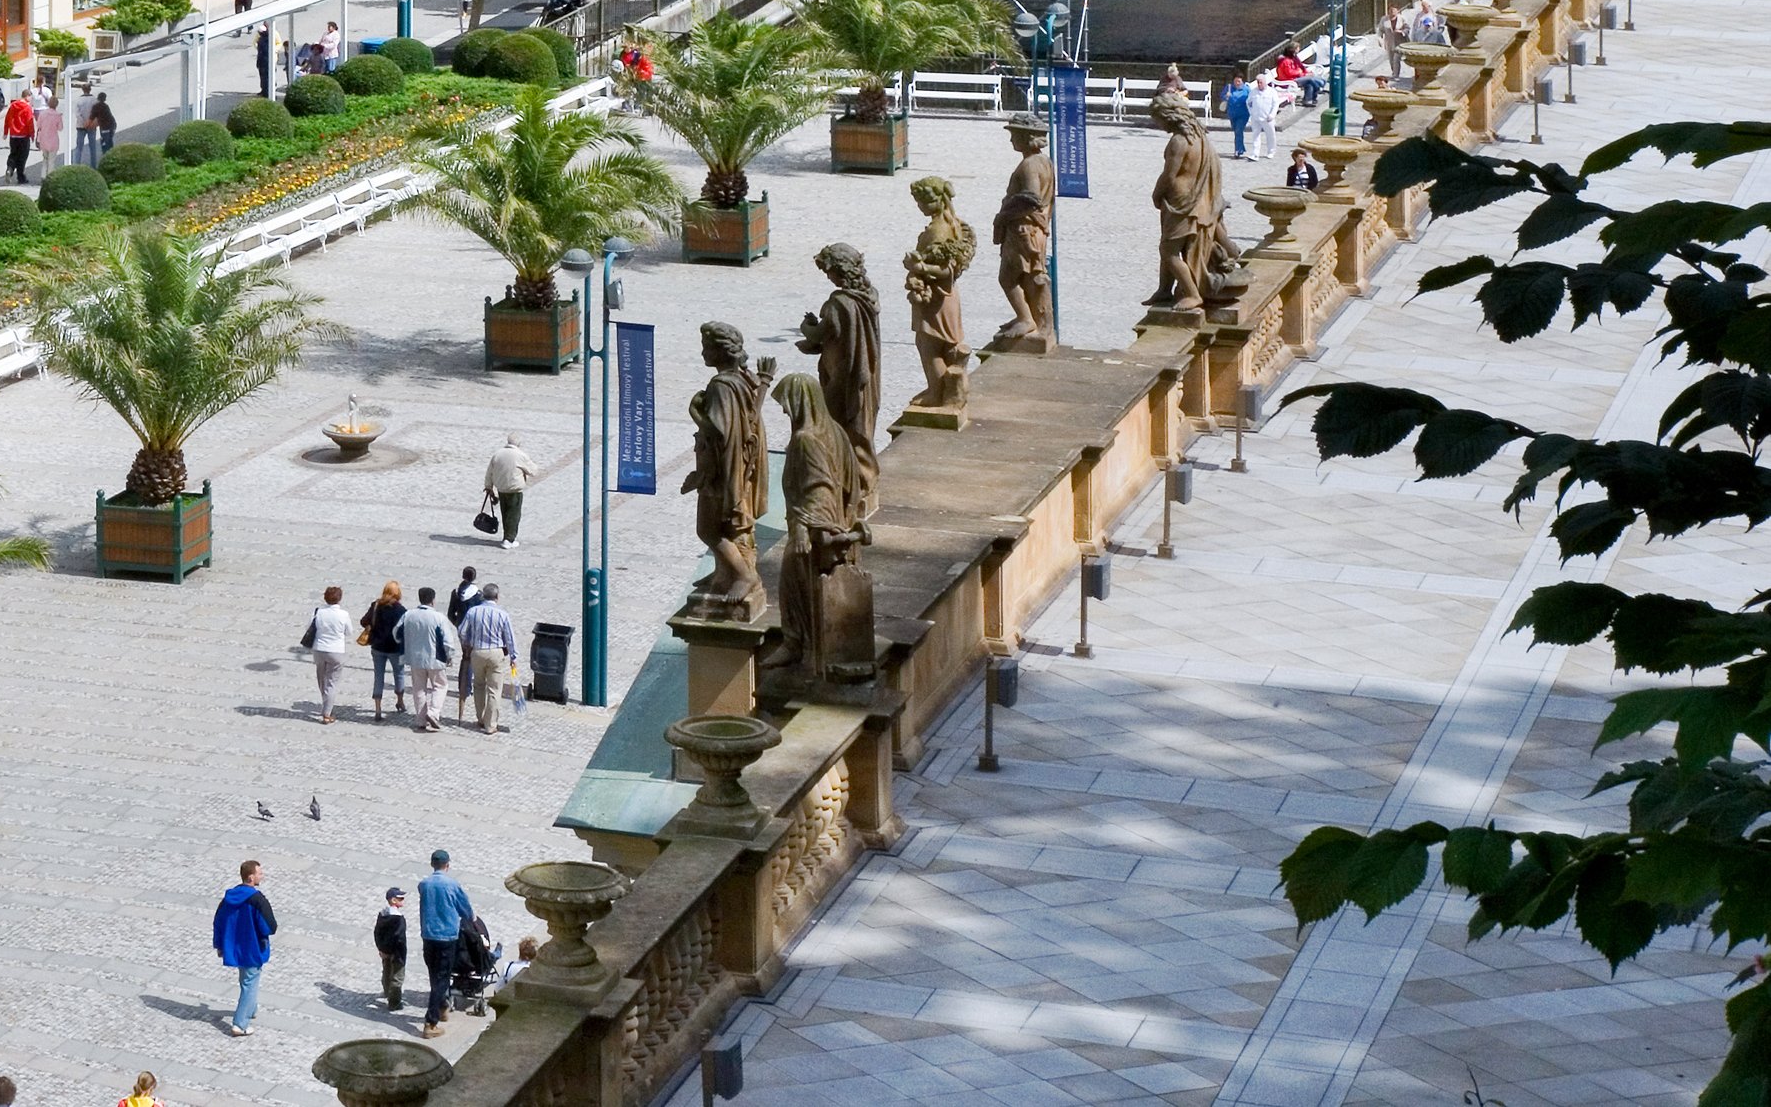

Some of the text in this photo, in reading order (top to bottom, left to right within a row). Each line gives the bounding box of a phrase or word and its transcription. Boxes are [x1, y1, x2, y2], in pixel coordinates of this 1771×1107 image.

[1069, 126, 1077, 174] Karlovy Vary
[622, 339, 631, 372] festival
[634, 400, 644, 463] Karlovy Vary
[644, 350, 653, 464] International Film Festival
